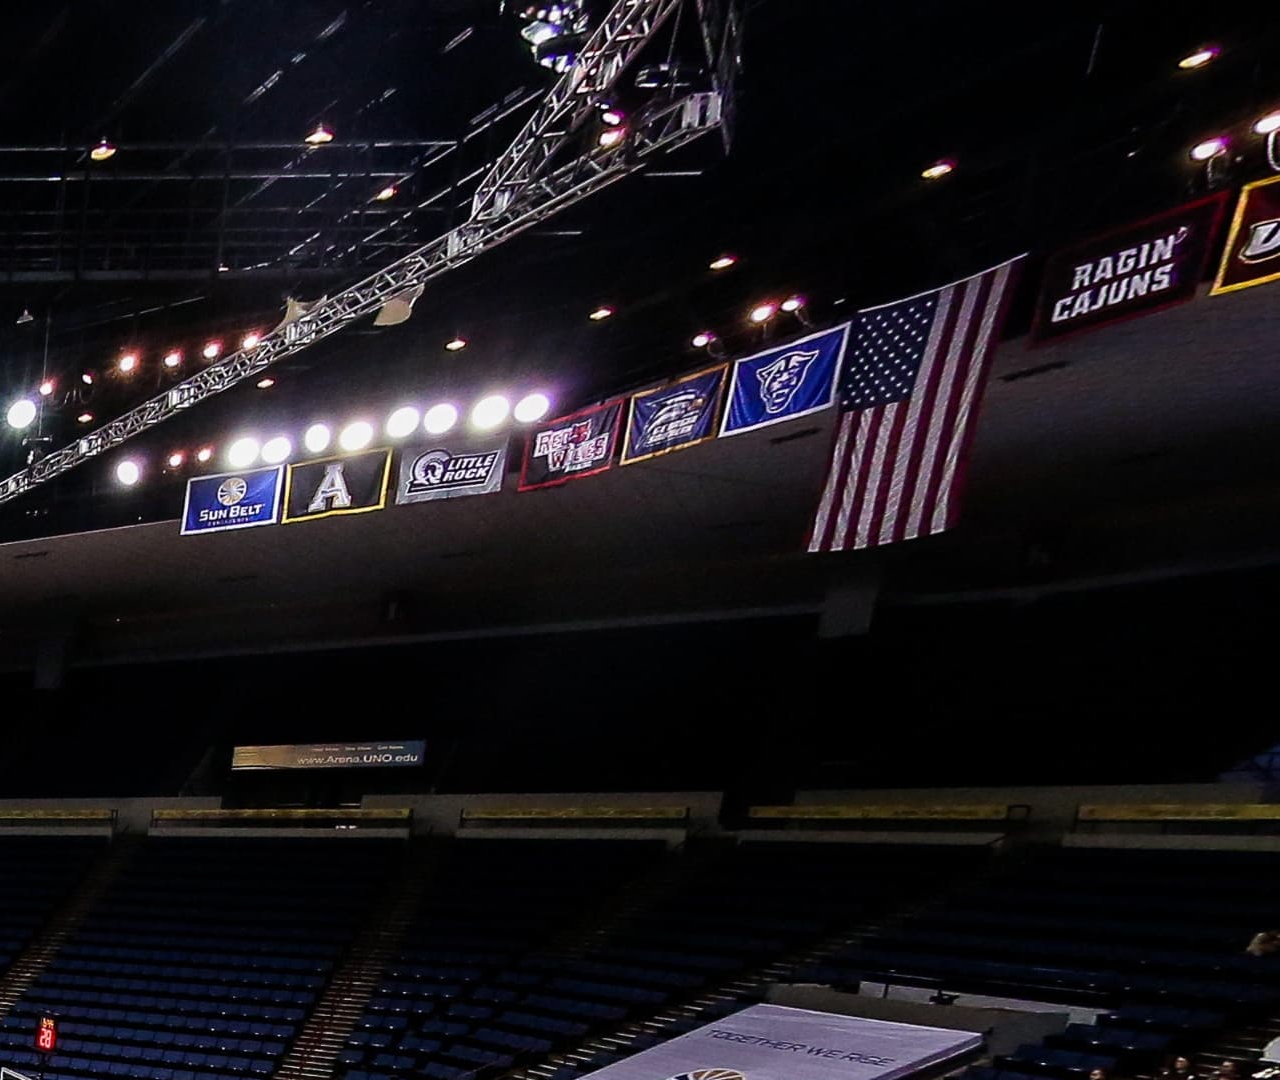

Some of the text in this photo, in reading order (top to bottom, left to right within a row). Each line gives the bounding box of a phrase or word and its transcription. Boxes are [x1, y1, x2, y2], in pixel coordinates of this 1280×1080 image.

[1072, 227, 1187, 290] RAGIN'
[1051, 263, 1175, 323] CAJUNS
[447, 453, 495, 472] LITTLE
[443, 466, 489, 483] ROCK
[307, 464, 352, 513] A
[199, 504, 262, 522] SUN BELT
[296, 753, 418, 765] www.Arena.UNO.edu
[40, 1028, 52, 1048] 28
[704, 1029, 897, 1069] TOGETHER WE RISE
